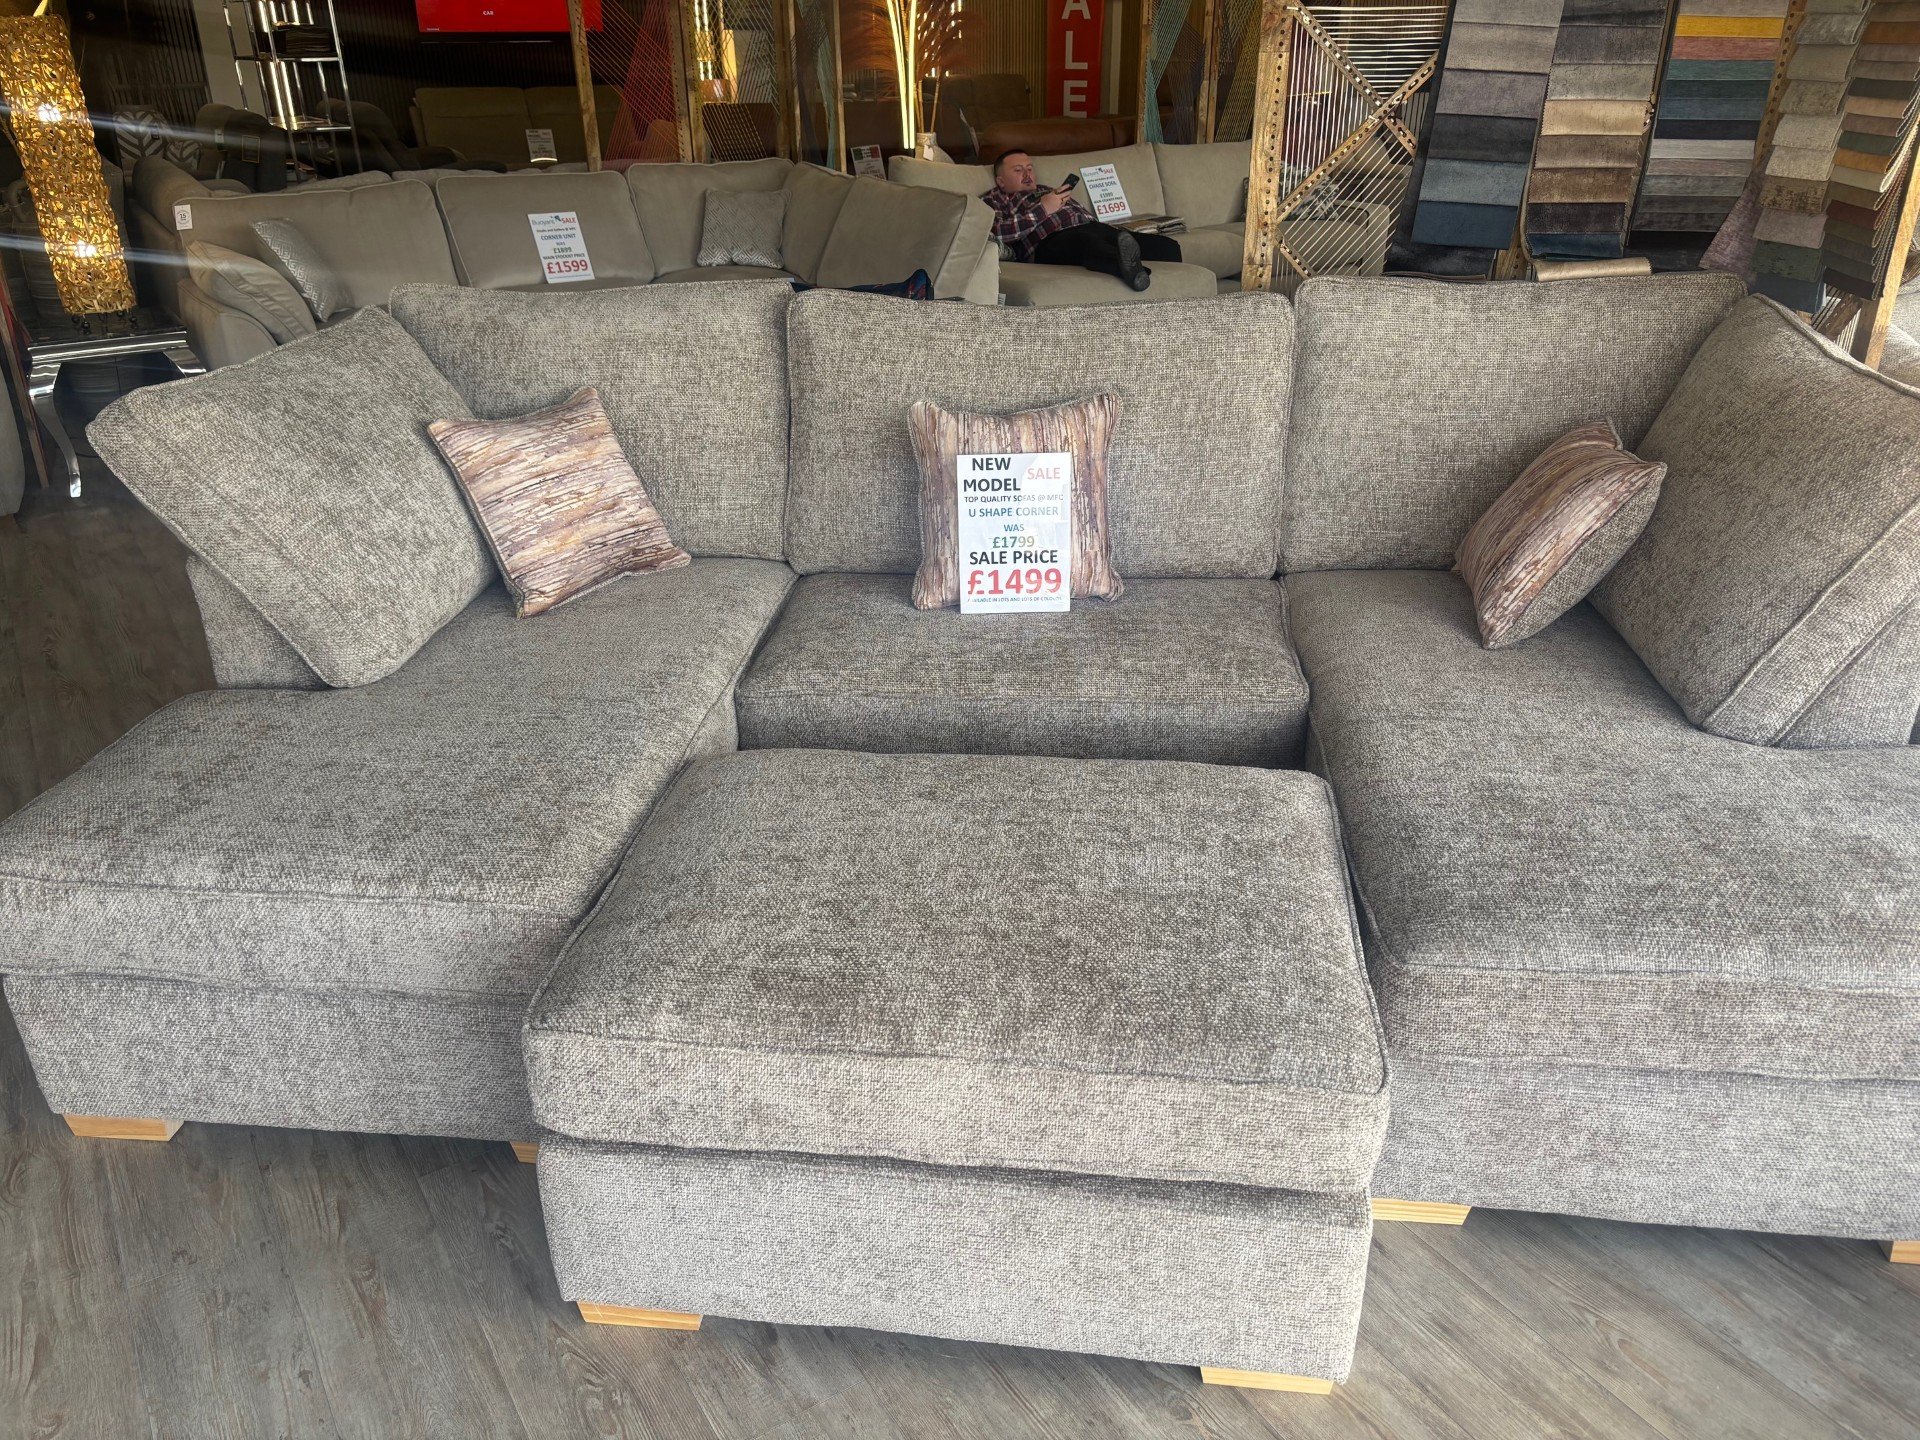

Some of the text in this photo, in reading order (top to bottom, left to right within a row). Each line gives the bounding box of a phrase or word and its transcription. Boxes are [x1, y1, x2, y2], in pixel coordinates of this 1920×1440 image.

[1097, 202, 1126, 214] £1699
[547, 260, 588, 274] £1599
[972, 457, 1011, 471] NEW
[1027, 467, 1061, 480] SALE
[963, 478, 1021, 492] MODEL
[980, 495, 1012, 503] QUALITY
[1013, 494, 1036, 502] SOFAS
[968, 506, 1059, 517] U SHAPE CORNER
[1003, 523, 1025, 532] WAS
[992, 536, 1035, 549] £1799
[969, 550, 1058, 565] SALE PRICE
[967, 568, 1062, 595] £1499
